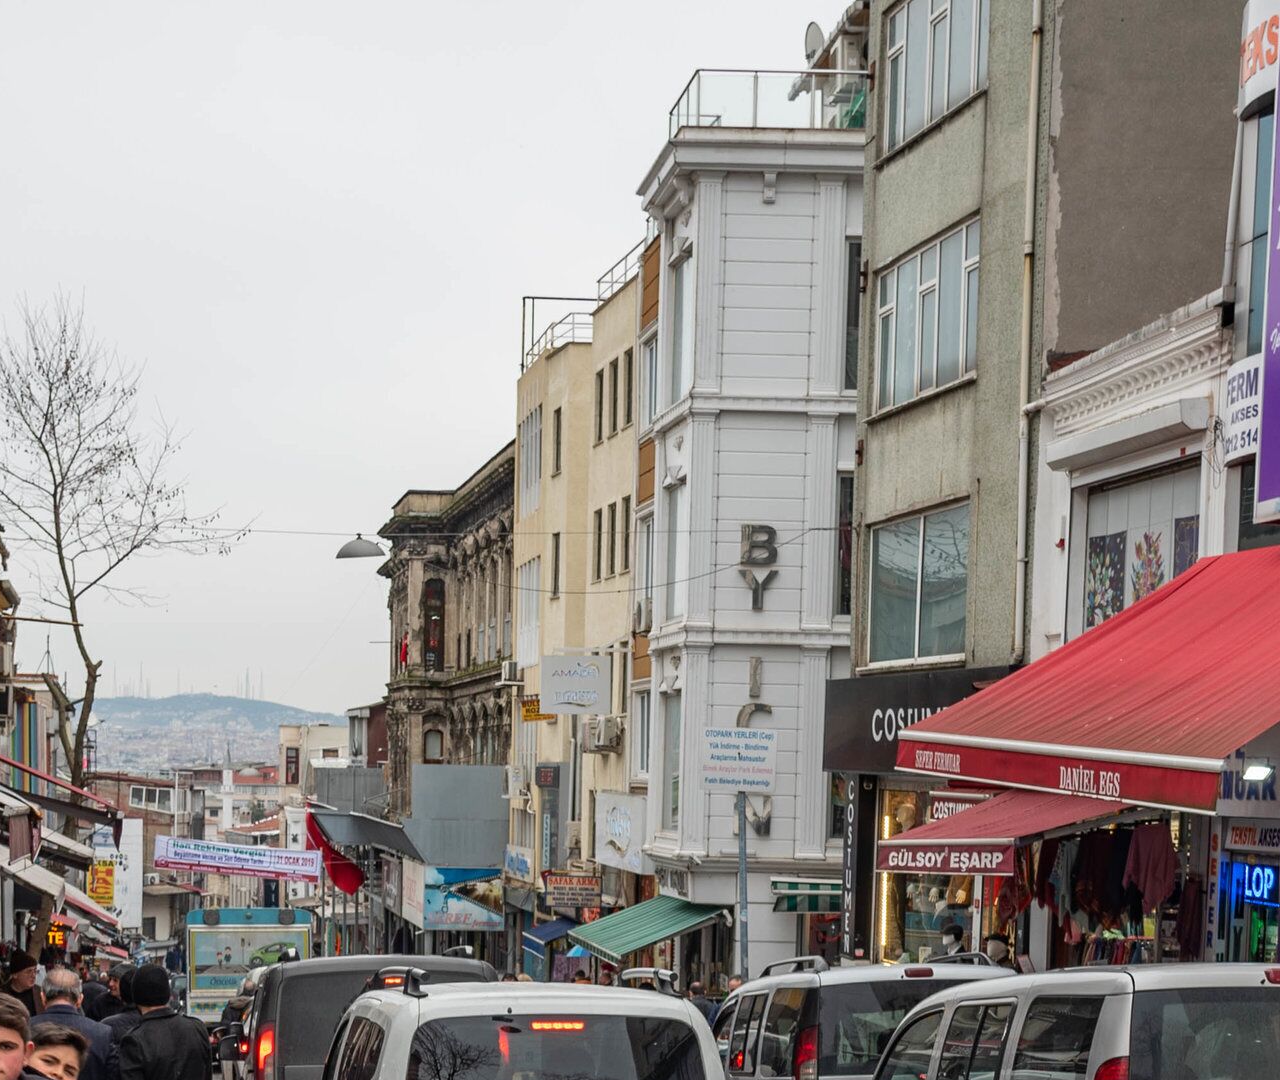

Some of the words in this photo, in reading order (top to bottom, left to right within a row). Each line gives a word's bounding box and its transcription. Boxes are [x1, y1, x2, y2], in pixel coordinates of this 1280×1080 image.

[1226, 367, 1259, 408] FERM
[1230, 404, 1259, 426] AKSES
[1240, 427, 1259, 448] 514
[705, 730, 732, 738] OTOPARK
[1059, 764, 1095, 794] DANİEL
[888, 848, 944, 868] GÜLSOY
[949, 851, 1004, 872] EŞARP
